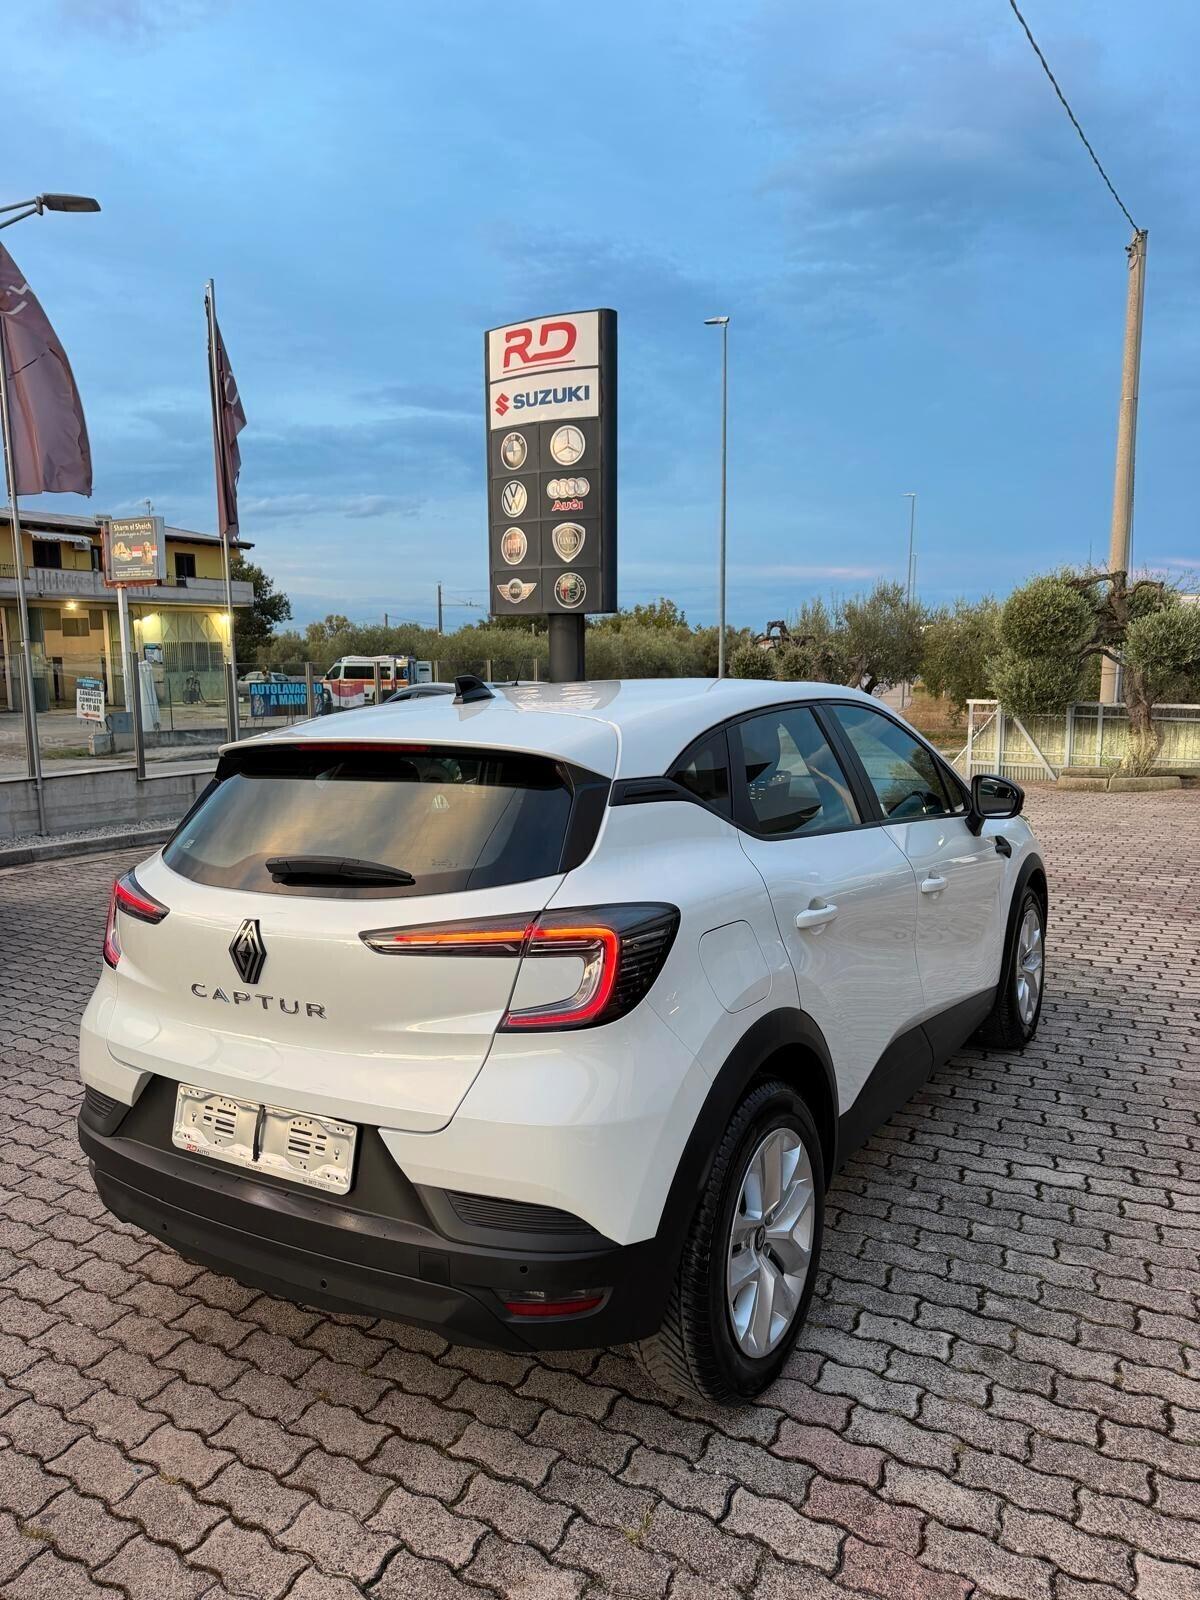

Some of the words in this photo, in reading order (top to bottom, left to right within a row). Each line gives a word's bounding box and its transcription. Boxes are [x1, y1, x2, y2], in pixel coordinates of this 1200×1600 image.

[503, 321, 577, 368] RD
[513, 385, 590, 409] SUZUKI
[551, 499, 584, 512] Audi
[251, 683, 322, 694] AUTOLAVAGIO
[79, 696, 102, 704] COMPLETO
[270, 694, 277, 705] A
[280, 694, 306, 705] MANO
[191, 983, 327, 1019] CAPTUR
